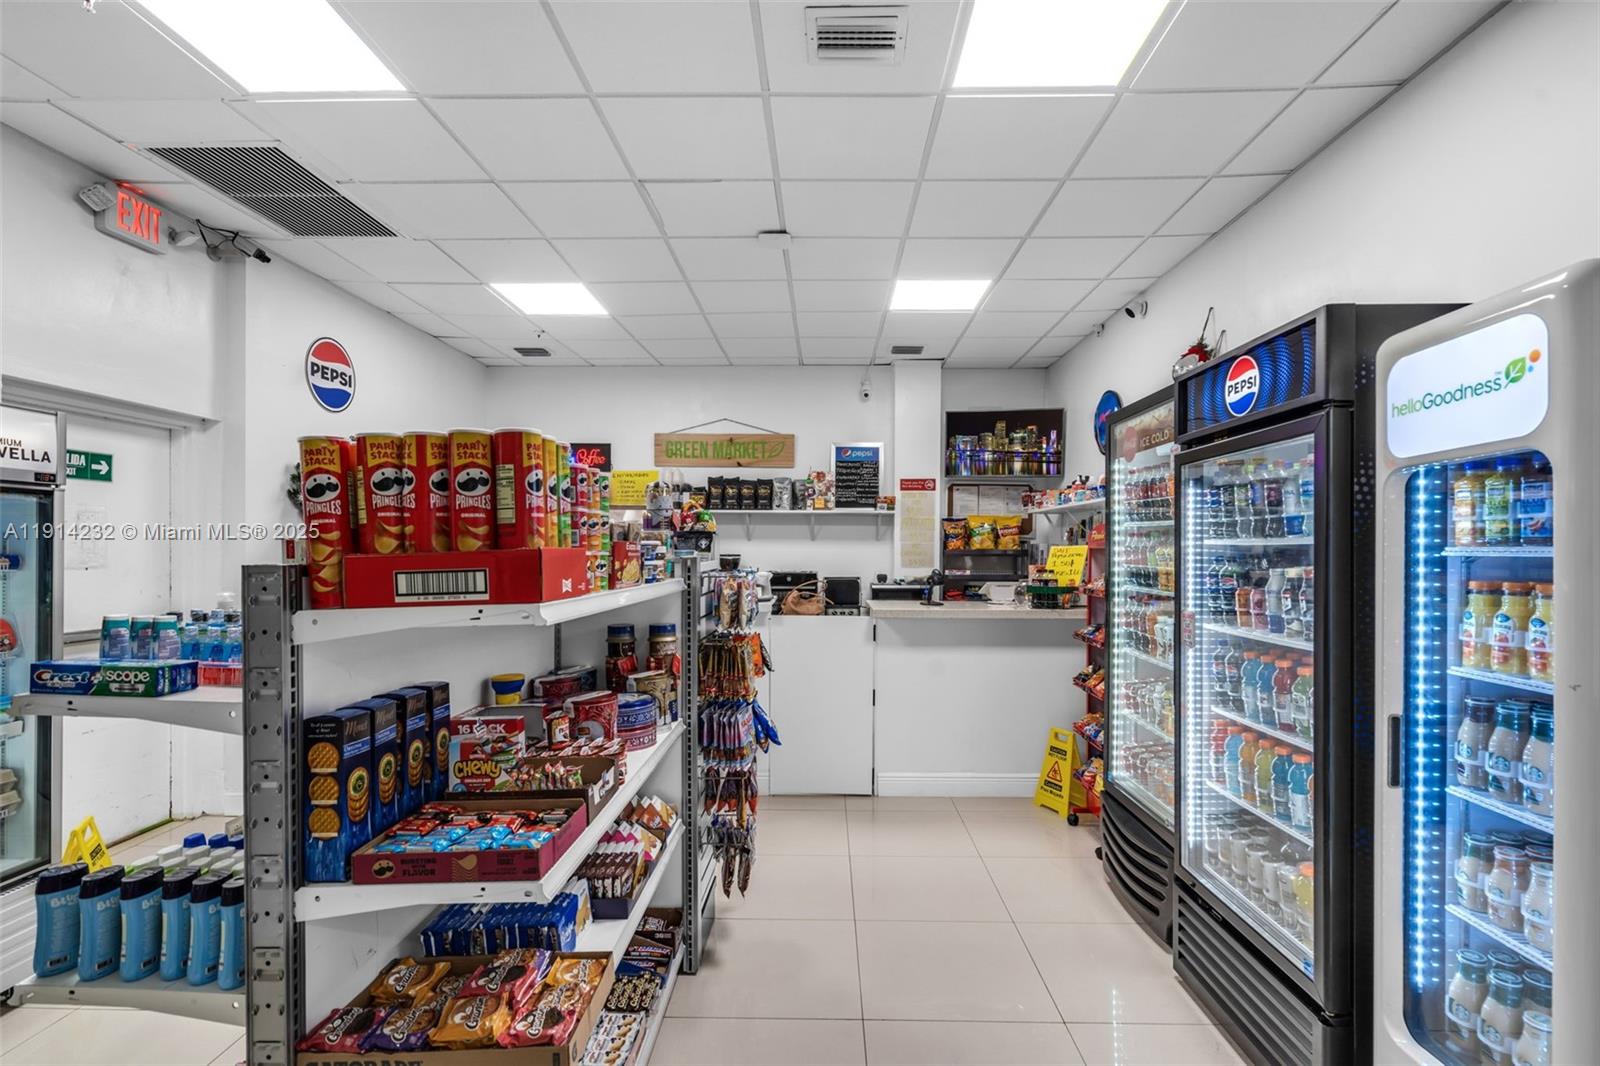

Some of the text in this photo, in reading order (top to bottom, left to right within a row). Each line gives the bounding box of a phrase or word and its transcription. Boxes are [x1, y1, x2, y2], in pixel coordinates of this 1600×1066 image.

[116, 191, 162, 245] EXIT
[310, 361, 353, 388] PEPSI
[1227, 375, 1257, 397] PEPSI
[1392, 377, 1503, 418] helloGoodness
[304, 446, 336, 458] PARTY
[430, 442, 448, 452] PAR
[456, 440, 488, 452] PARTY
[664, 440, 768, 459] GREEN MARKET
[457, 451, 488, 461] STACK
[576, 448, 606, 466] Coffee
[852, 450, 873, 458] pepsi
[304, 456, 336, 467] STACK
[305, 500, 342, 517] PRINGLES
[430, 495, 448, 509] PRIN
[455, 494, 492, 510] PRINGLES
[34, 670, 90, 683] Crest
[106, 670, 150, 684] scope
[458, 724, 470, 735] 16
[402, 868, 436, 877] FLAVOR
